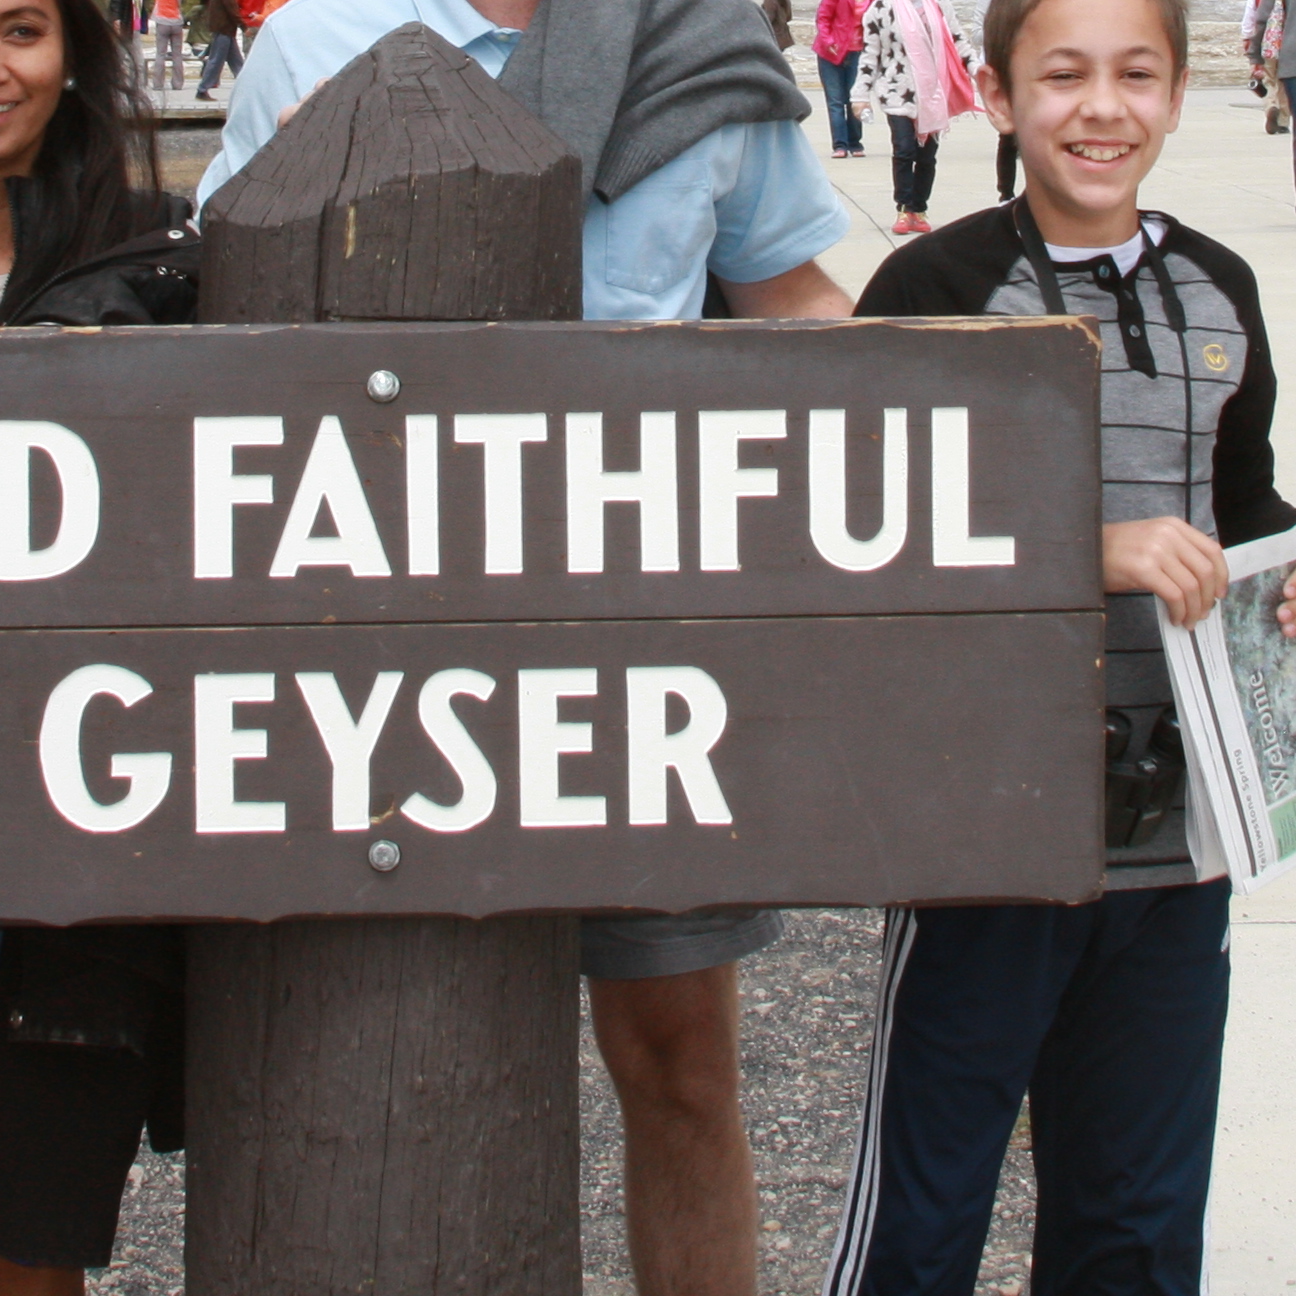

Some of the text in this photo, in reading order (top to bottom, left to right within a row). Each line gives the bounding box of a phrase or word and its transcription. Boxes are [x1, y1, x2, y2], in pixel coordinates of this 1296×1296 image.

[194, 407, 1015, 578] FAITHFUL
[40, 665, 732, 833] GEYSER
[1233, 749, 1250, 792] Spring
[1250, 670, 1290, 798] Welcome
